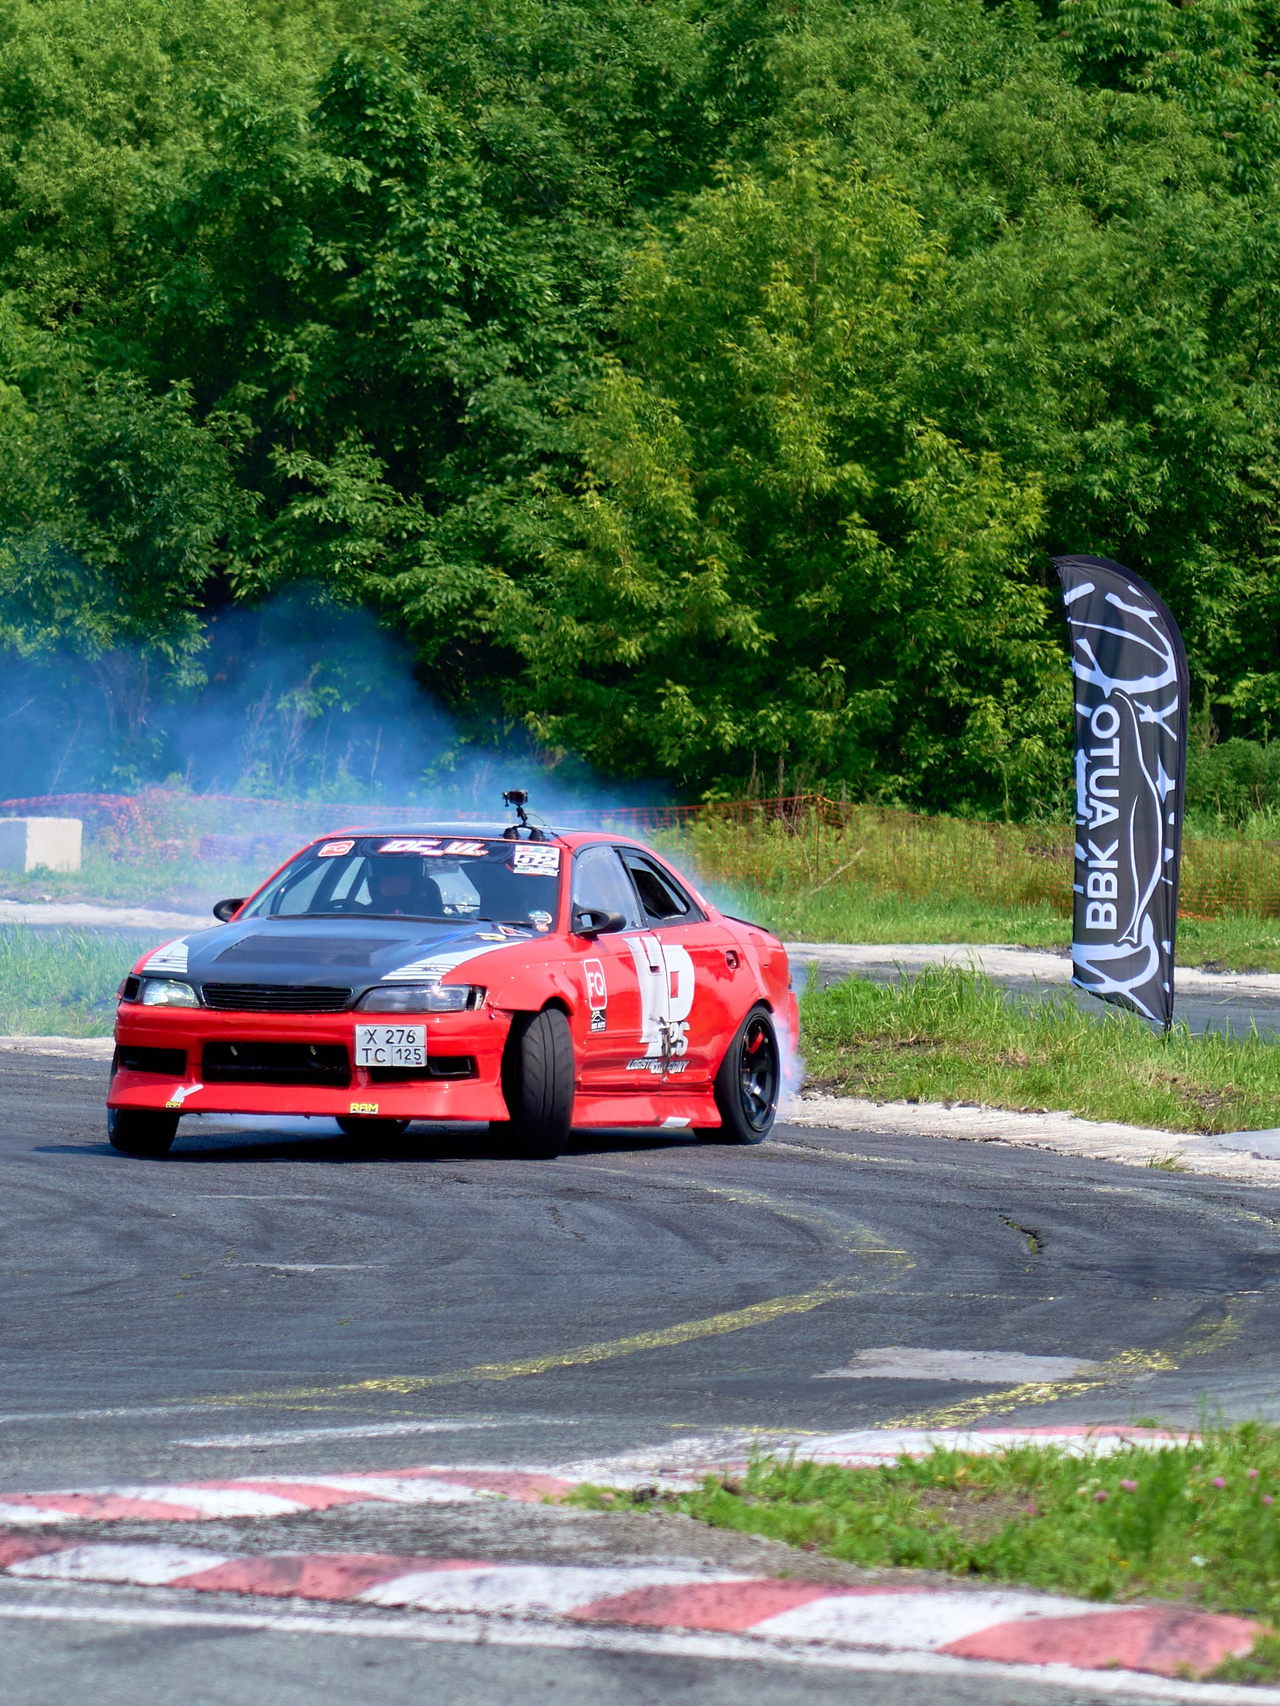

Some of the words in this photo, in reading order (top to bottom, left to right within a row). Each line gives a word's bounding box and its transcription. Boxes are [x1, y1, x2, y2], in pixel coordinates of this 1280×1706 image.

[324, 843, 349, 854] FQ
[588, 972, 605, 998] FQ
[385, 1029, 416, 1044] 276
[395, 1048, 422, 1061] 125
[350, 1102, 379, 1113] RAM
